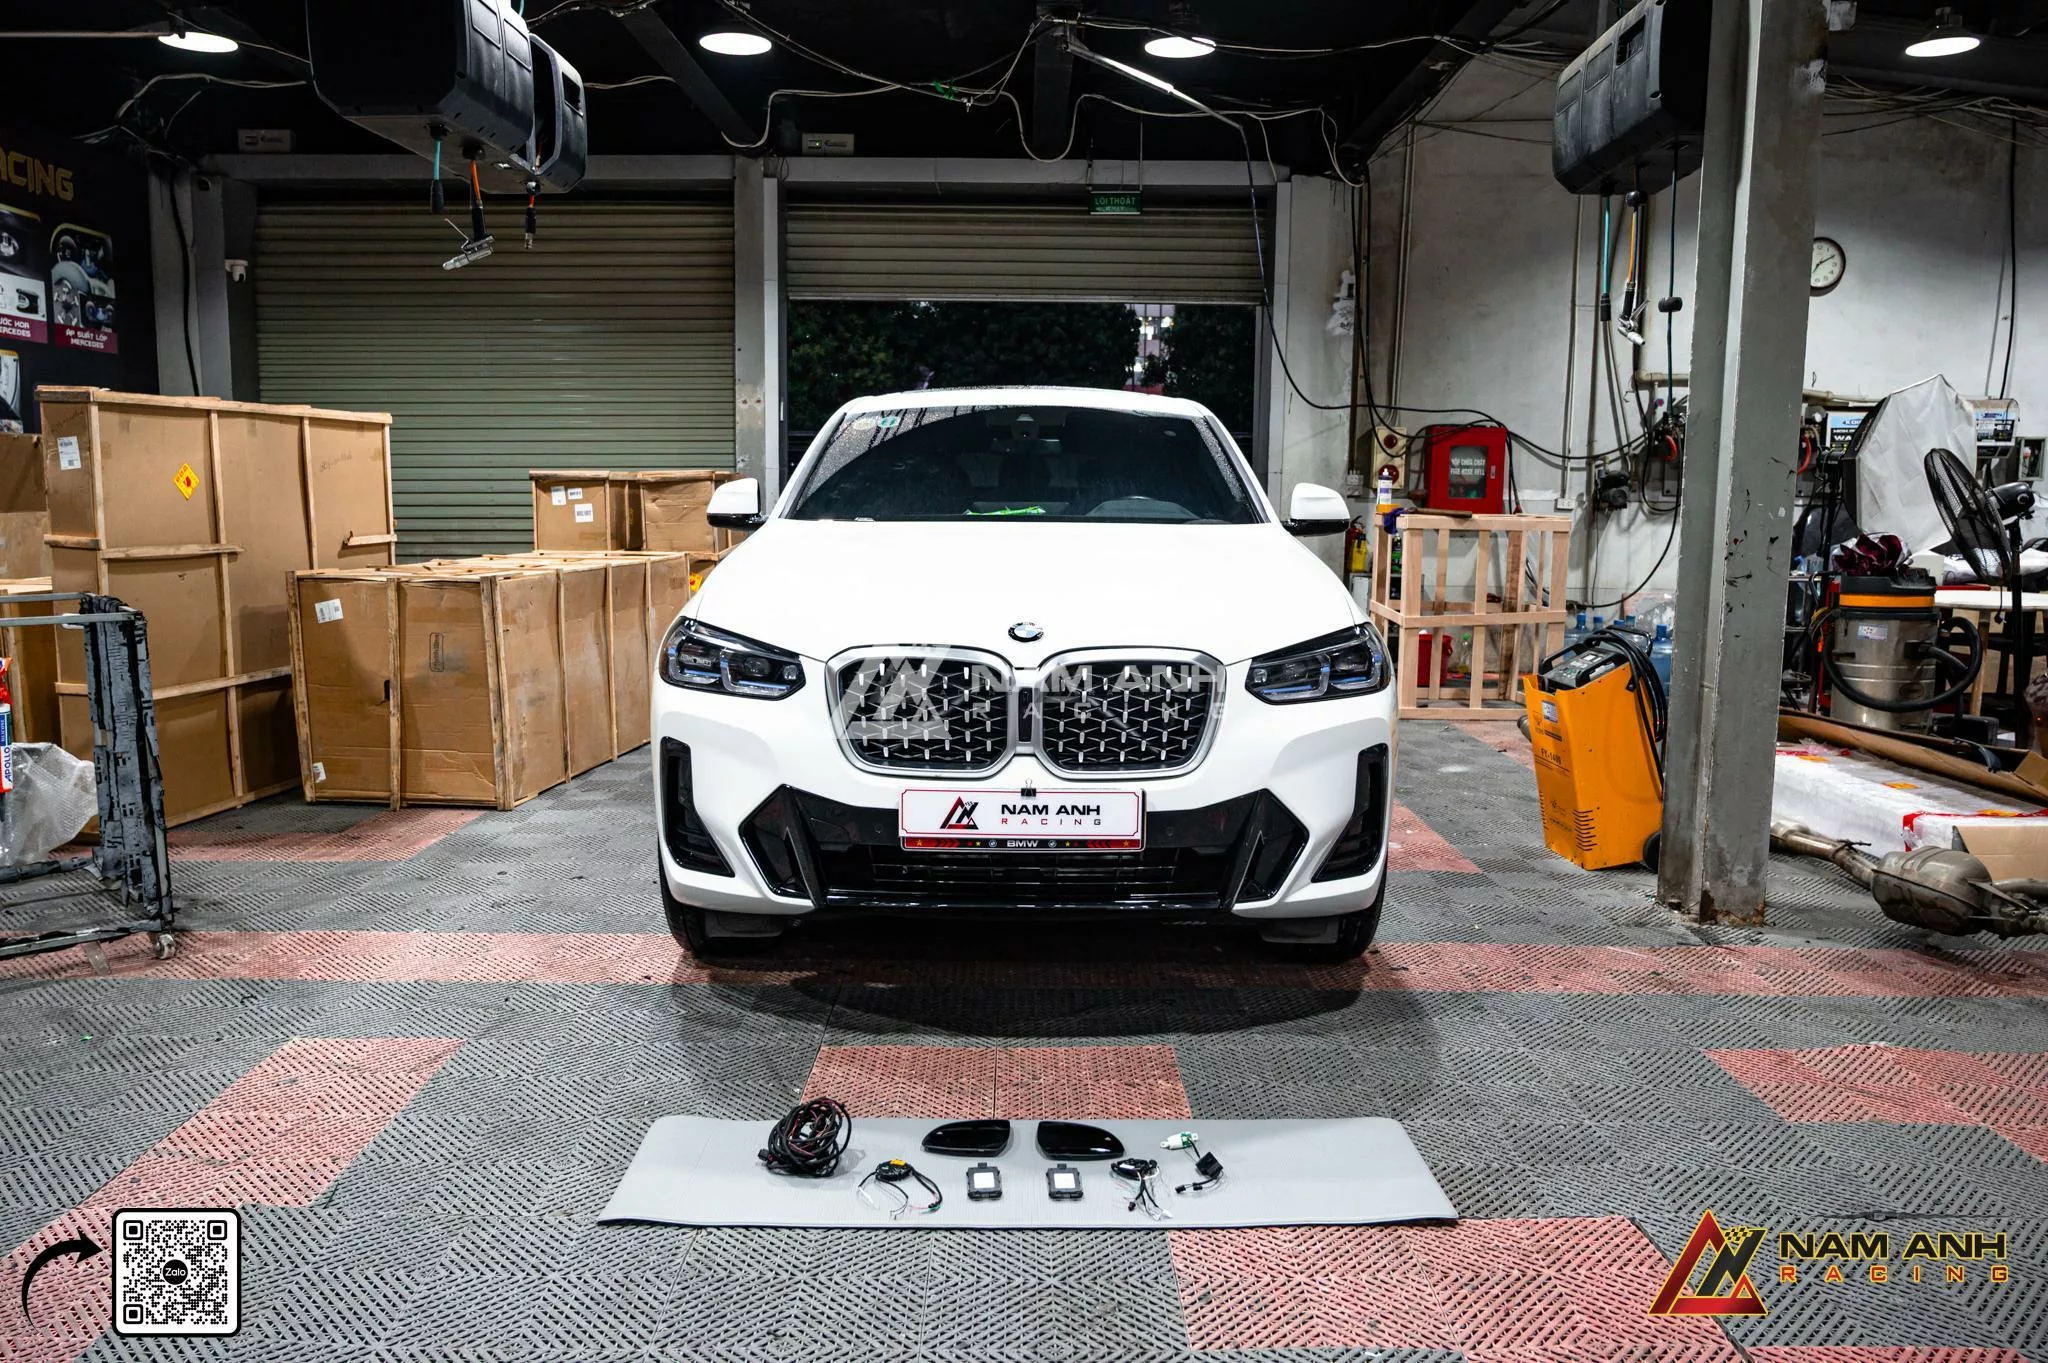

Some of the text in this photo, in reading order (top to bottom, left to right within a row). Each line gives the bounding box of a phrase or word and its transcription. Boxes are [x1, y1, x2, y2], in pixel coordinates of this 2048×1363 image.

[70, 338, 104, 349] MERCEDES
[1001, 805, 1101, 816] NAM ANH
[1001, 818, 1102, 826] RACING
[1006, 839, 1039, 848] BMW
